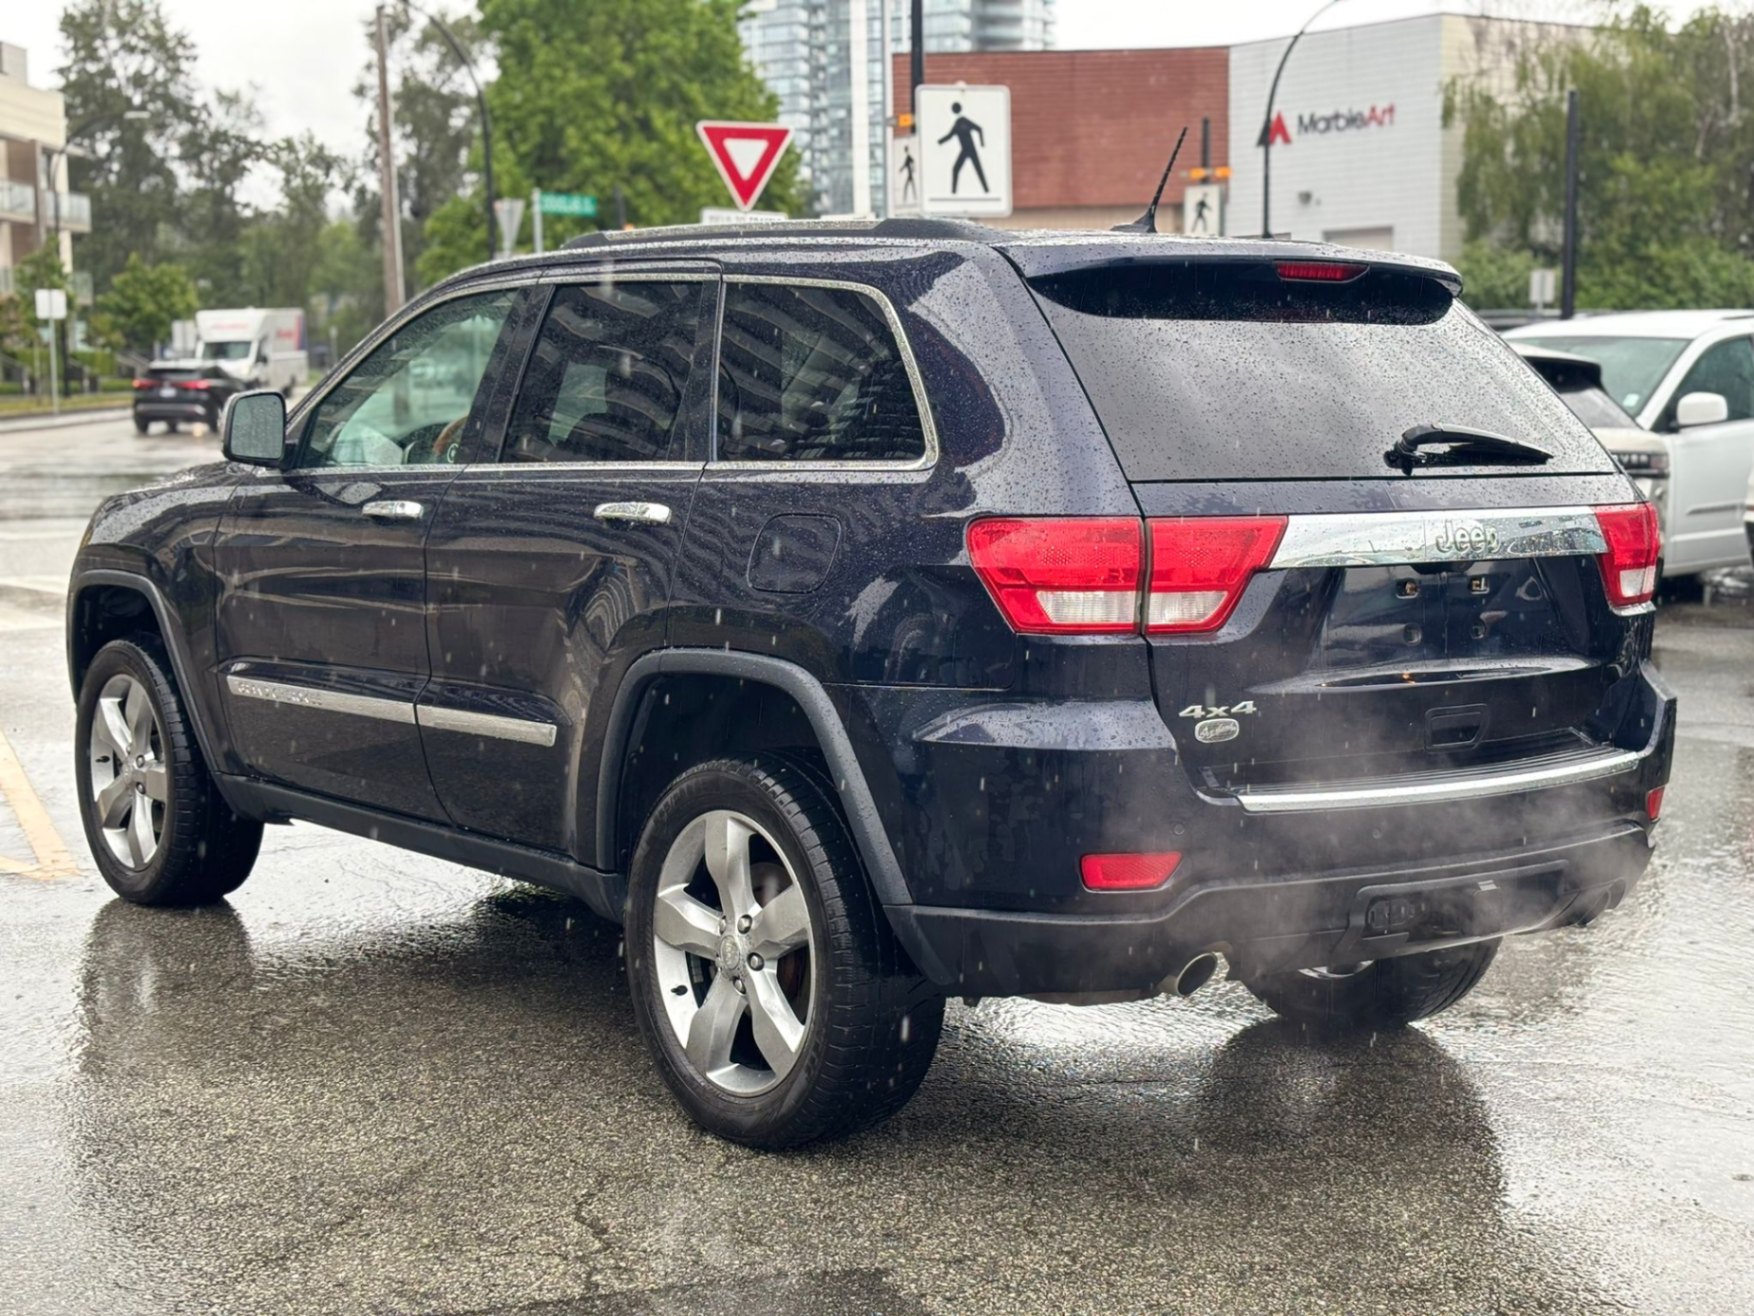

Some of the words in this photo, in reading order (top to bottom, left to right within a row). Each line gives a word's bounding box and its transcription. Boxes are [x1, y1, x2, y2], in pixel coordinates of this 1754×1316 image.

[1298, 103, 1395, 135] MarbleArt
[1436, 519, 1501, 554] Jeep
[1178, 701, 1257, 718] 4x4
